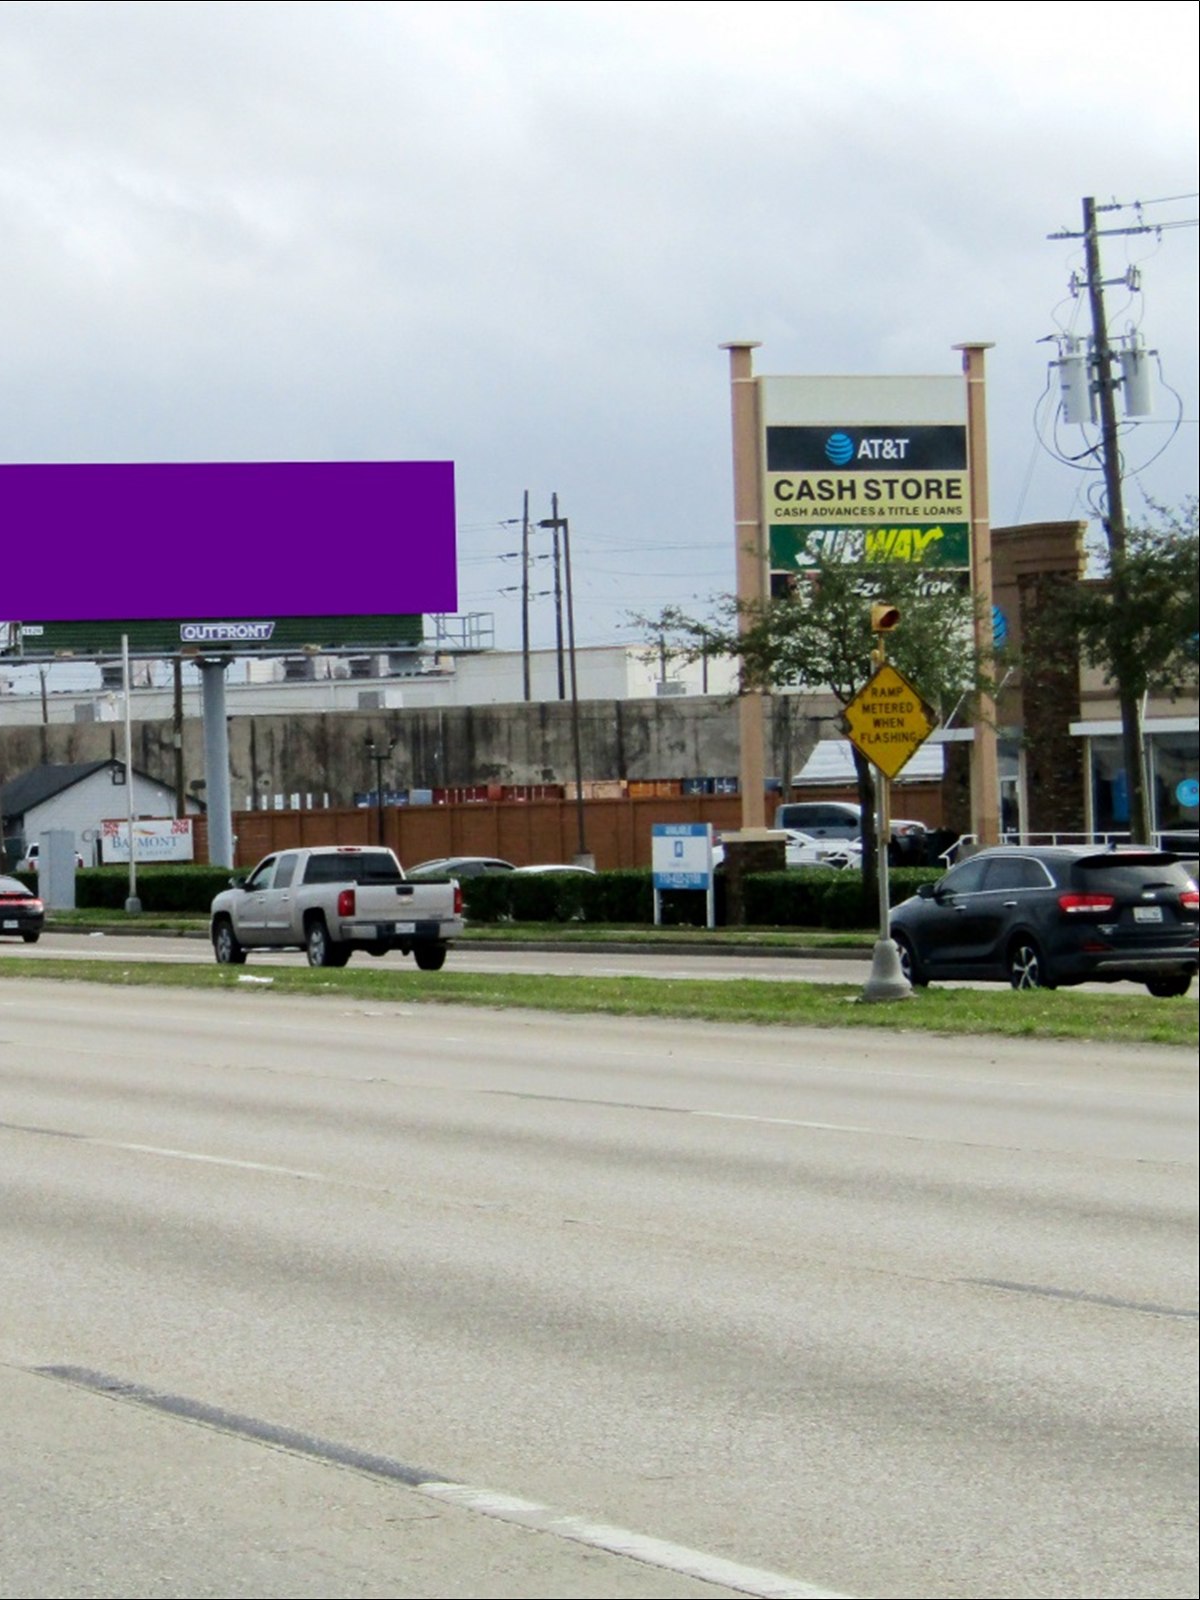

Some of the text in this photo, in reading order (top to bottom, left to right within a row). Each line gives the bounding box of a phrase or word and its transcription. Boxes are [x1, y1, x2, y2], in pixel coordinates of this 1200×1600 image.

[857, 438, 910, 460] AT&T
[774, 478, 963, 501] CASH STORE
[774, 506, 963, 518] CASH ADVANCES & TITLE LOANS
[795, 526, 944, 566] SUBWAY
[184, 624, 271, 639] OUTFRONT
[871, 687, 904, 698] RAMP
[861, 702, 914, 715] METERED
[872, 718, 905, 729] WHEN
[860, 732, 917, 744] FLASHING
